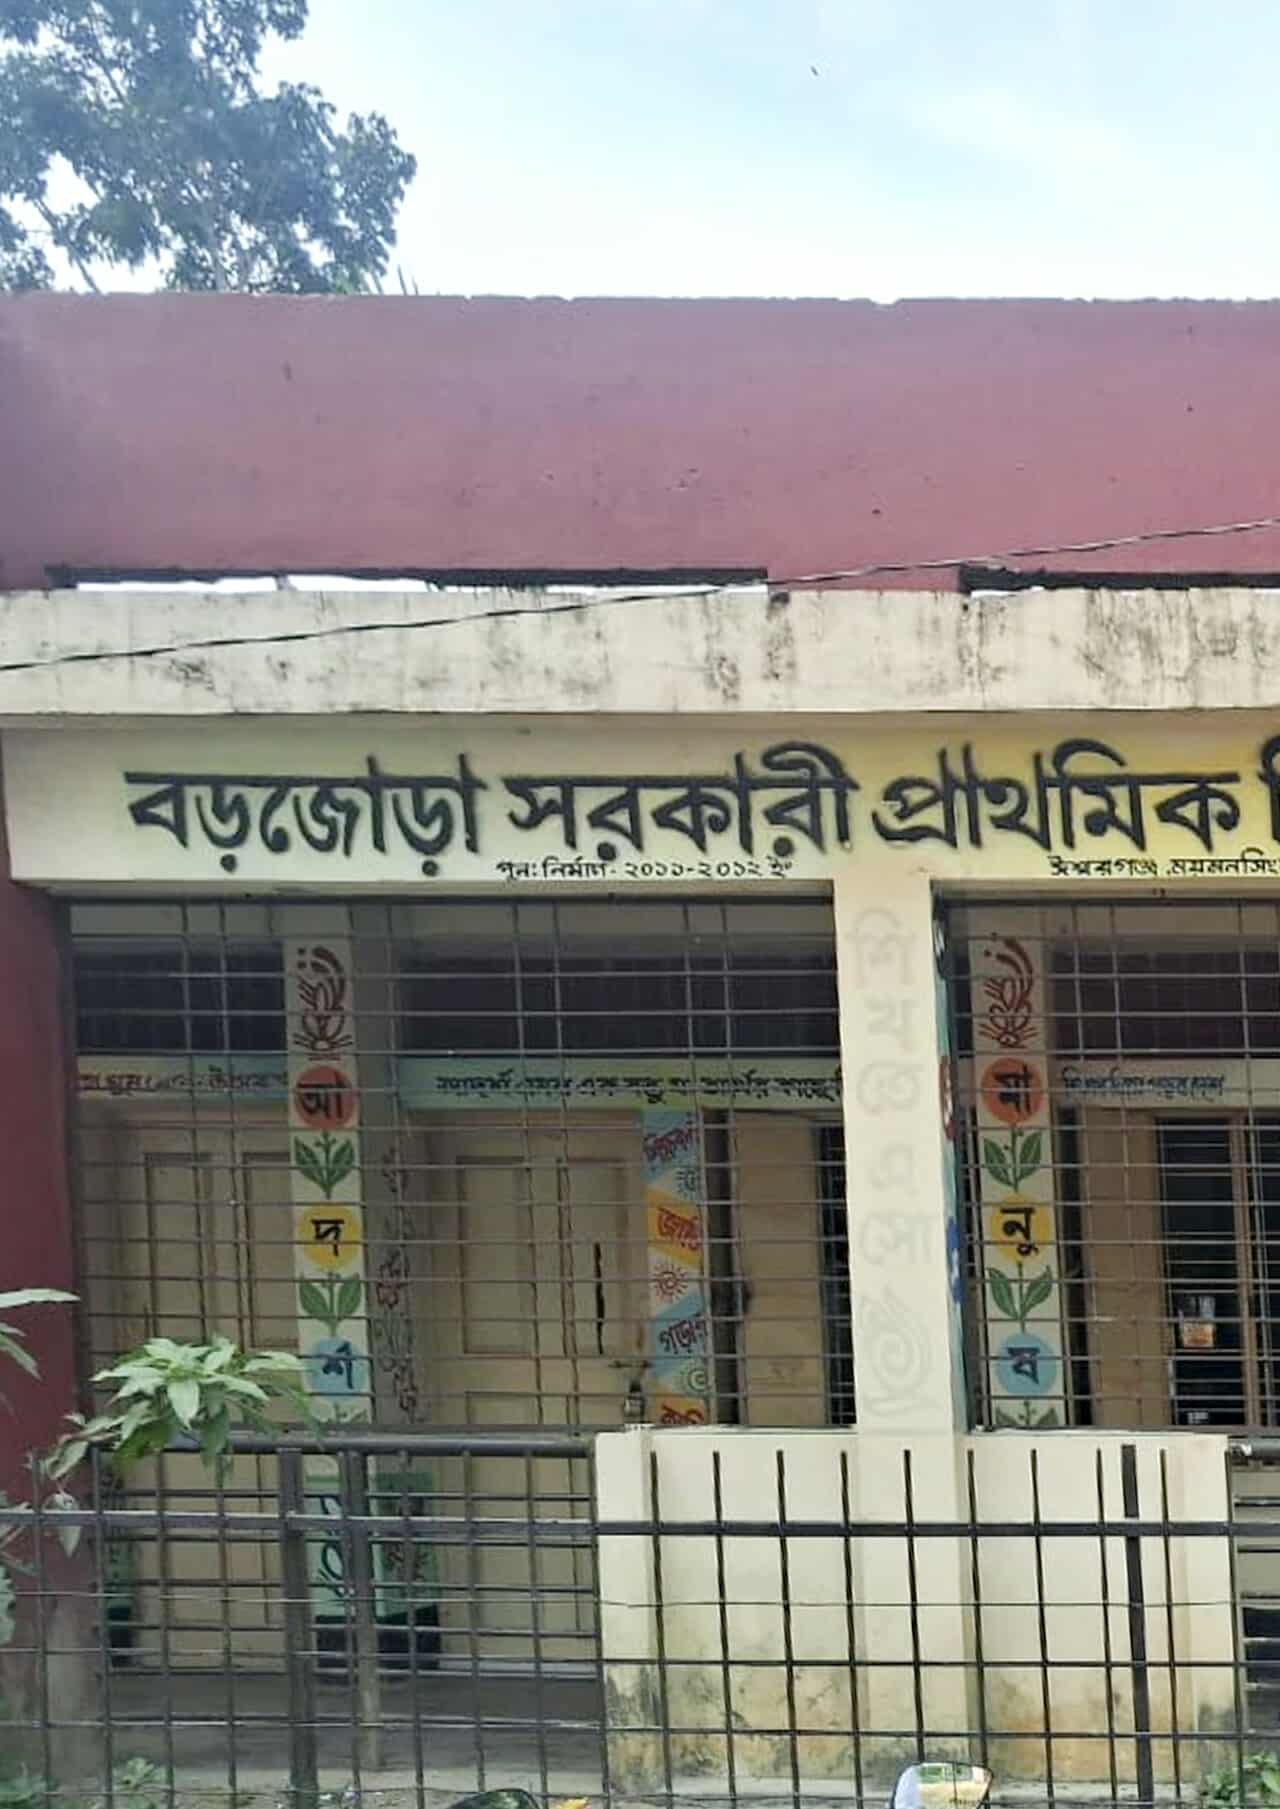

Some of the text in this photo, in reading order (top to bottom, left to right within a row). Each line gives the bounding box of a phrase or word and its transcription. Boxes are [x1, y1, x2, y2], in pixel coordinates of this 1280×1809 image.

[124, 752, 488, 876] বড়জোড়া
[504, 740, 862, 863] সরকারী
[871, 736, 1242, 851] প্রাথমিক
